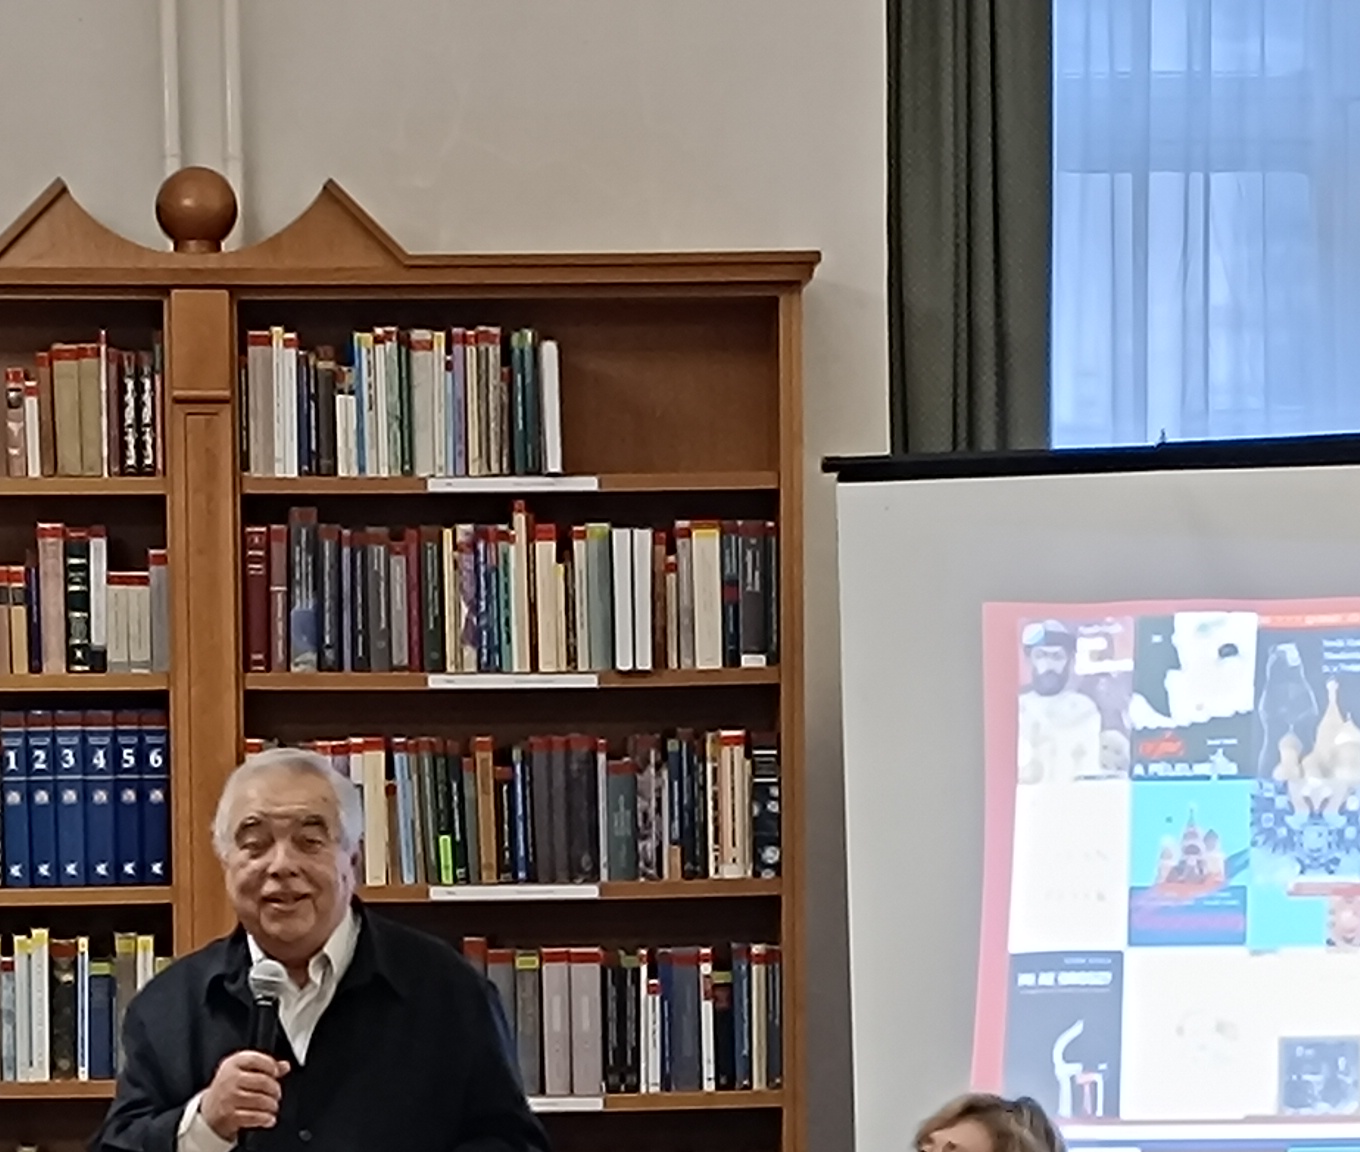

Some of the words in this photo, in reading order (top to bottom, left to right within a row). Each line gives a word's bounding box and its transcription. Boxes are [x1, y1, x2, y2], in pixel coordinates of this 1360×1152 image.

[6, 749, 18, 770] 1
[32, 750, 46, 769] 2
[61, 749, 75, 769] 3
[93, 748, 106, 769] 4
[122, 748, 135, 768] 5
[149, 748, 162, 768] 6
